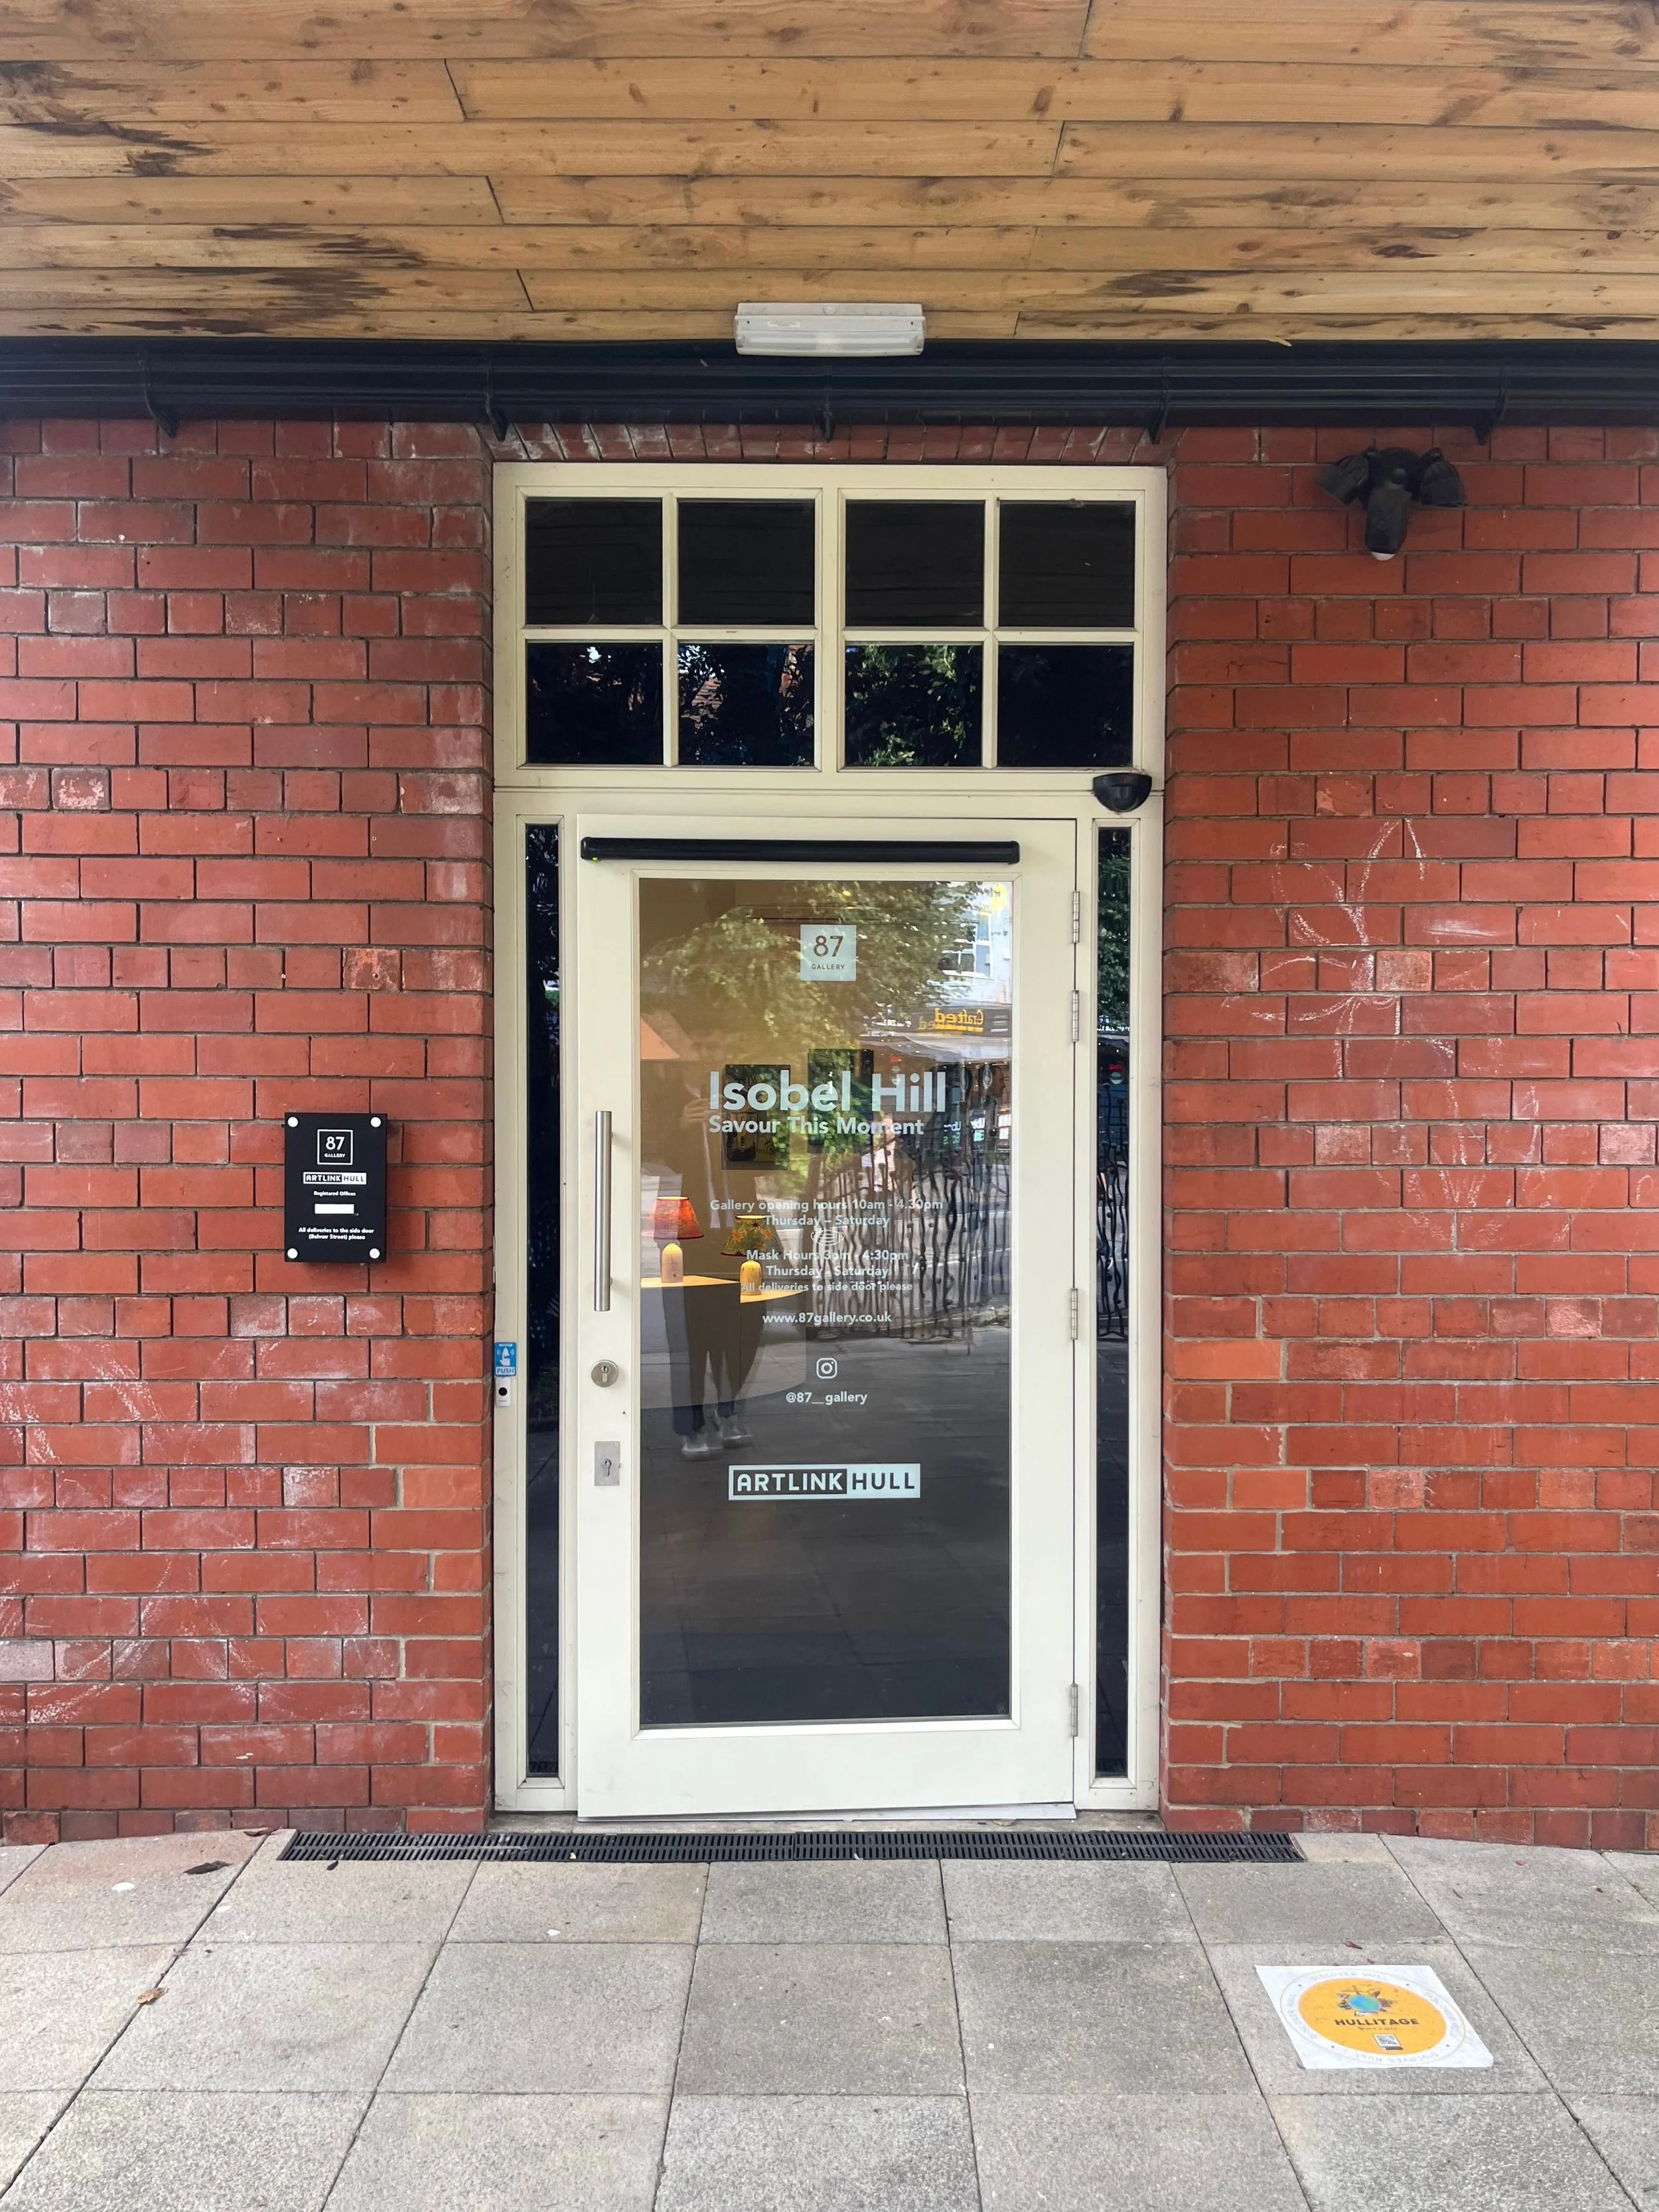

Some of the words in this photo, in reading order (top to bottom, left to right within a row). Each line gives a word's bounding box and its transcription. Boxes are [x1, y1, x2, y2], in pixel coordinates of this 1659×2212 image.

[813, 935, 843, 957] 87
[710, 1070, 851, 1111] Isobel
[872, 1071, 946, 1113] Hill
[709, 1115, 781, 1133] Savour
[787, 1116, 828, 1134] This
[836, 1117, 924, 1135] Moment
[326, 1137, 345, 1150] 87
[710, 1200, 755, 1211] Gallery
[759, 1200, 809, 1211] opening
[813, 1200, 847, 1211] hours
[852, 1200, 885, 1211] 10am
[765, 1215, 820, 1227] Thursday
[835, 1215, 890, 1227] Saturday
[747, 1250, 779, 1260] Mask
[783, 1250, 820, 1261] Hours
[766, 1265, 822, 1279] Thursday
[835, 1266, 889, 1279] Saturday
[758, 1282, 809, 1292] deliveries
[827, 1282, 847, 1292] side
[851, 1282, 876, 1291] door
[879, 1282, 913, 1292] please
[762, 1312, 892, 1326] www.87gallery.co.uk
[737, 1472, 843, 1491] ARTLINK
[852, 1472, 914, 1490] HULL
